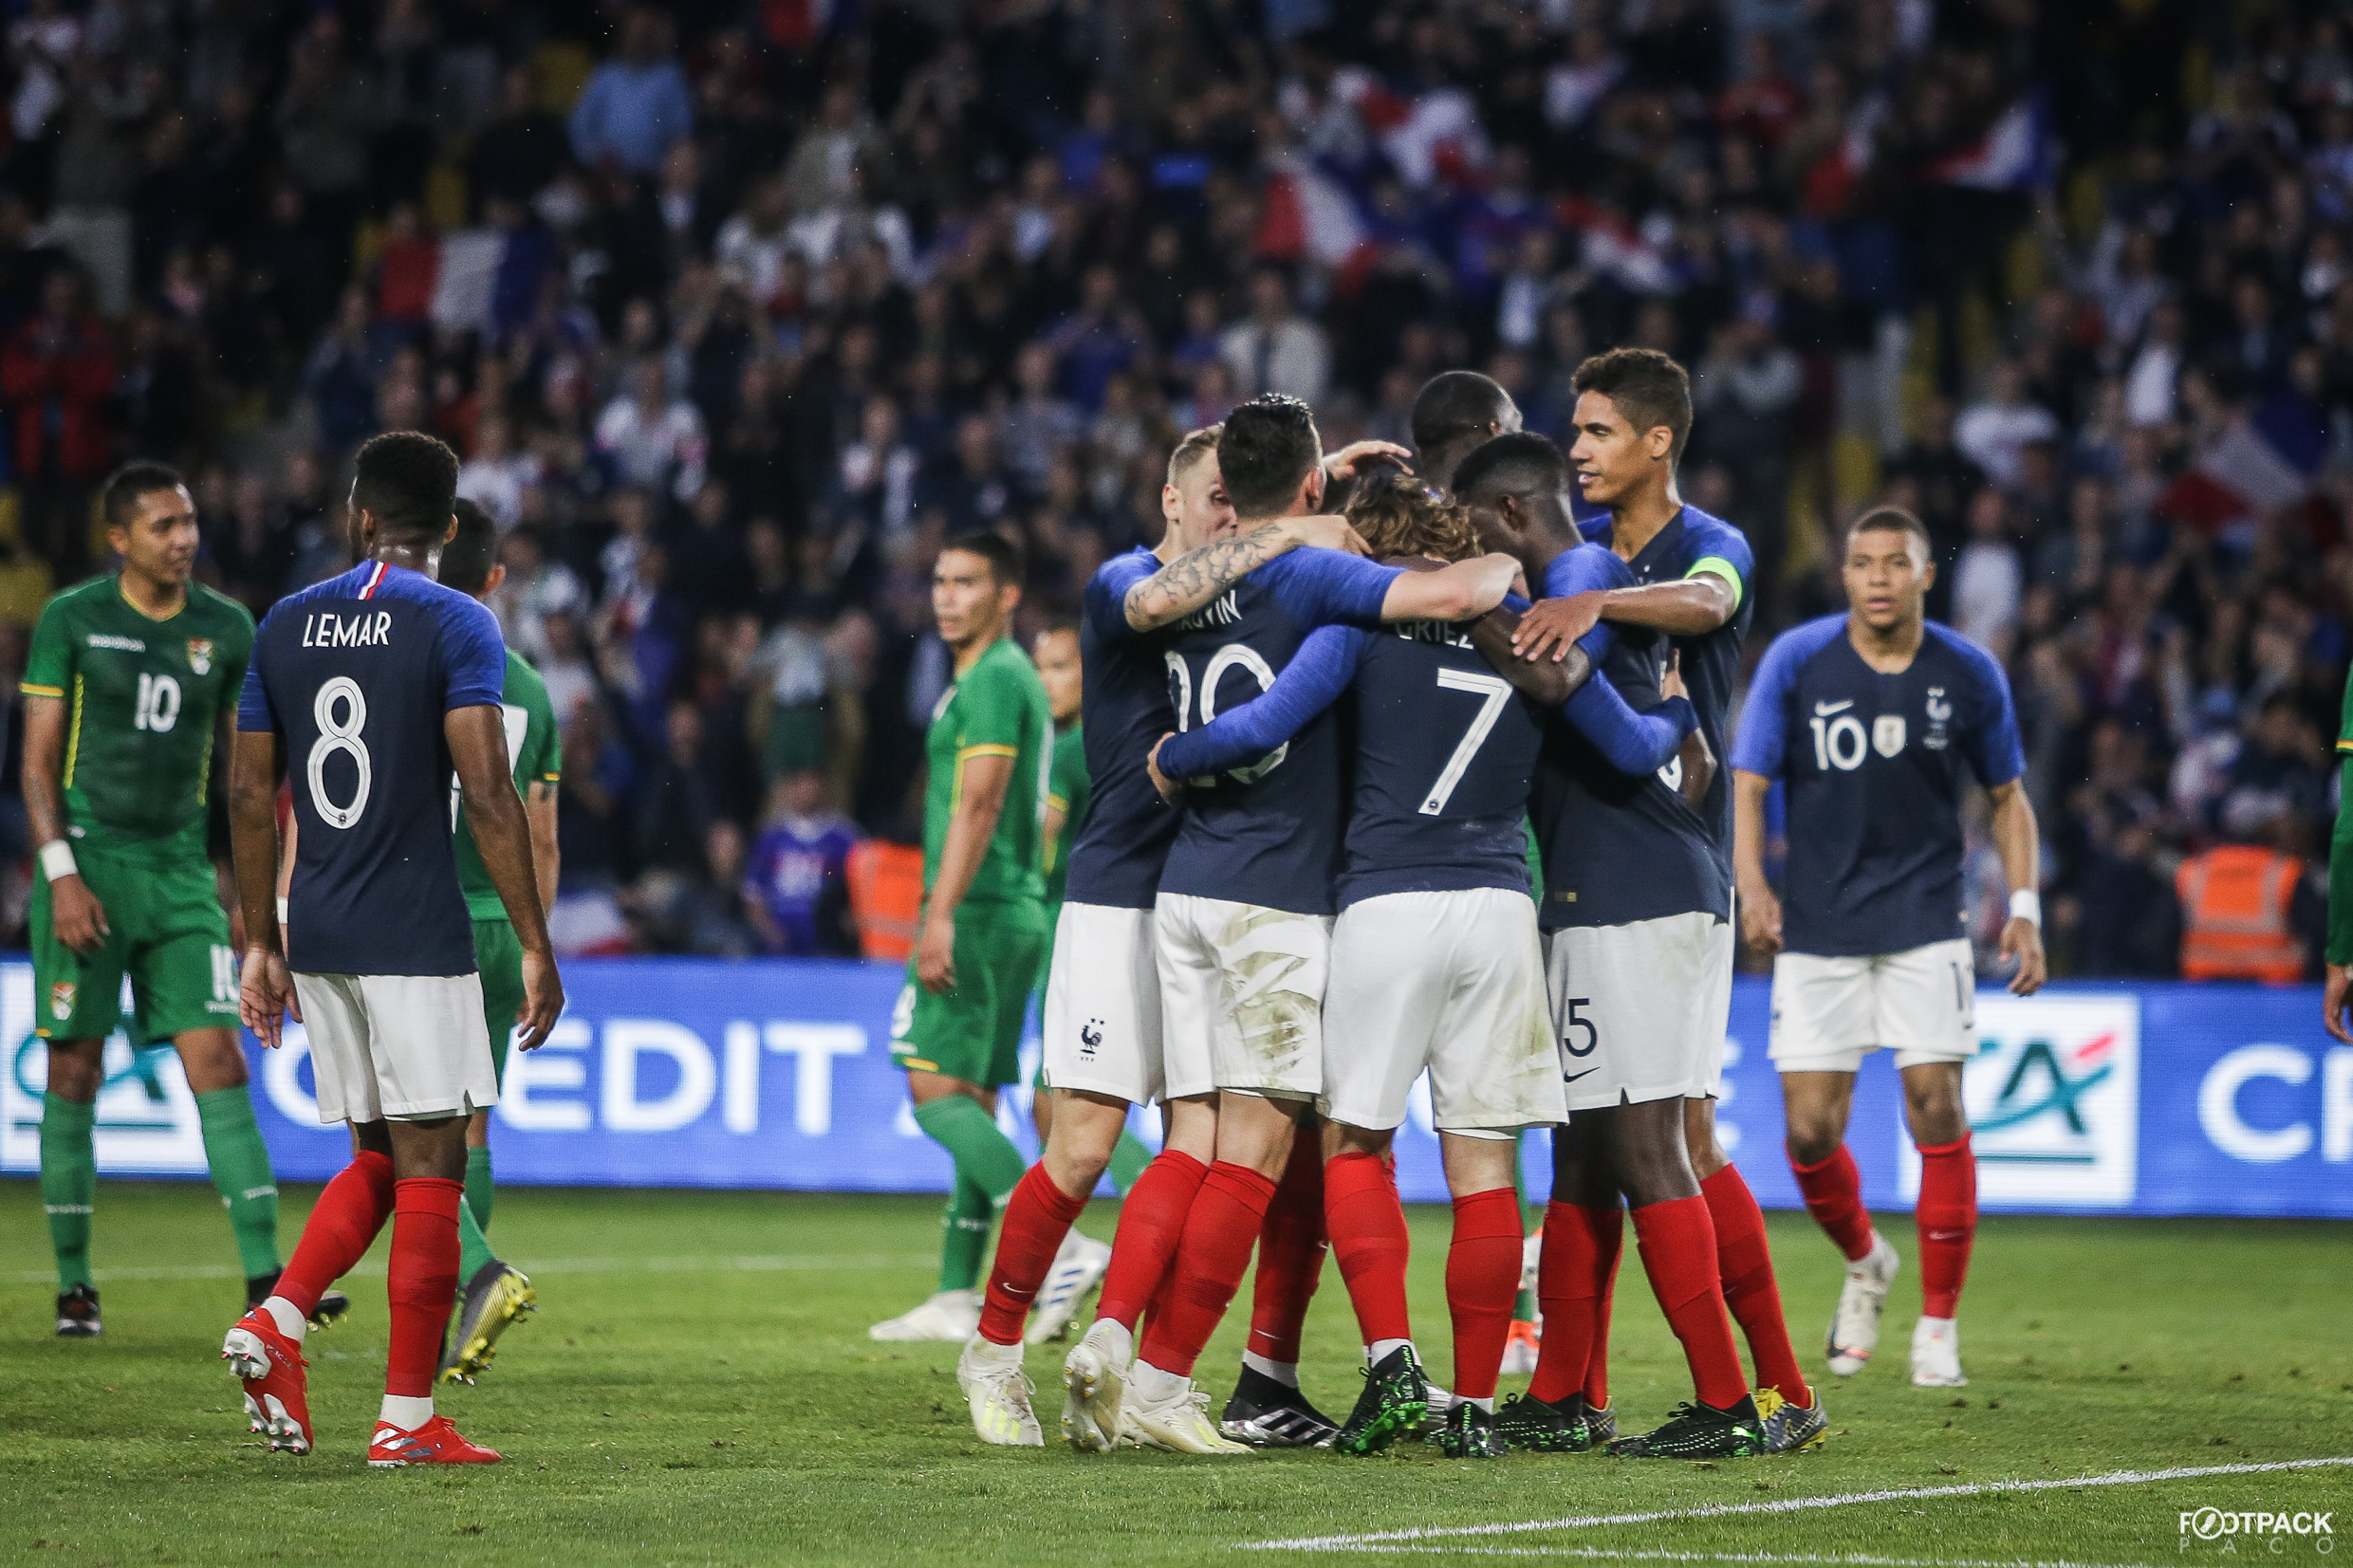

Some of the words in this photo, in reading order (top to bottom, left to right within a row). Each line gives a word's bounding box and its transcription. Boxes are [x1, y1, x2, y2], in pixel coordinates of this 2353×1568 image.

[302, 611, 392, 648] LEMAR
[134, 673, 182, 733] 10
[307, 675, 372, 830] 8
[1417, 667, 1514, 817] 7
[1809, 715, 1867, 771] 10
[1563, 997, 1598, 1058] 5
[264, 1017, 868, 1136] CEDIT
